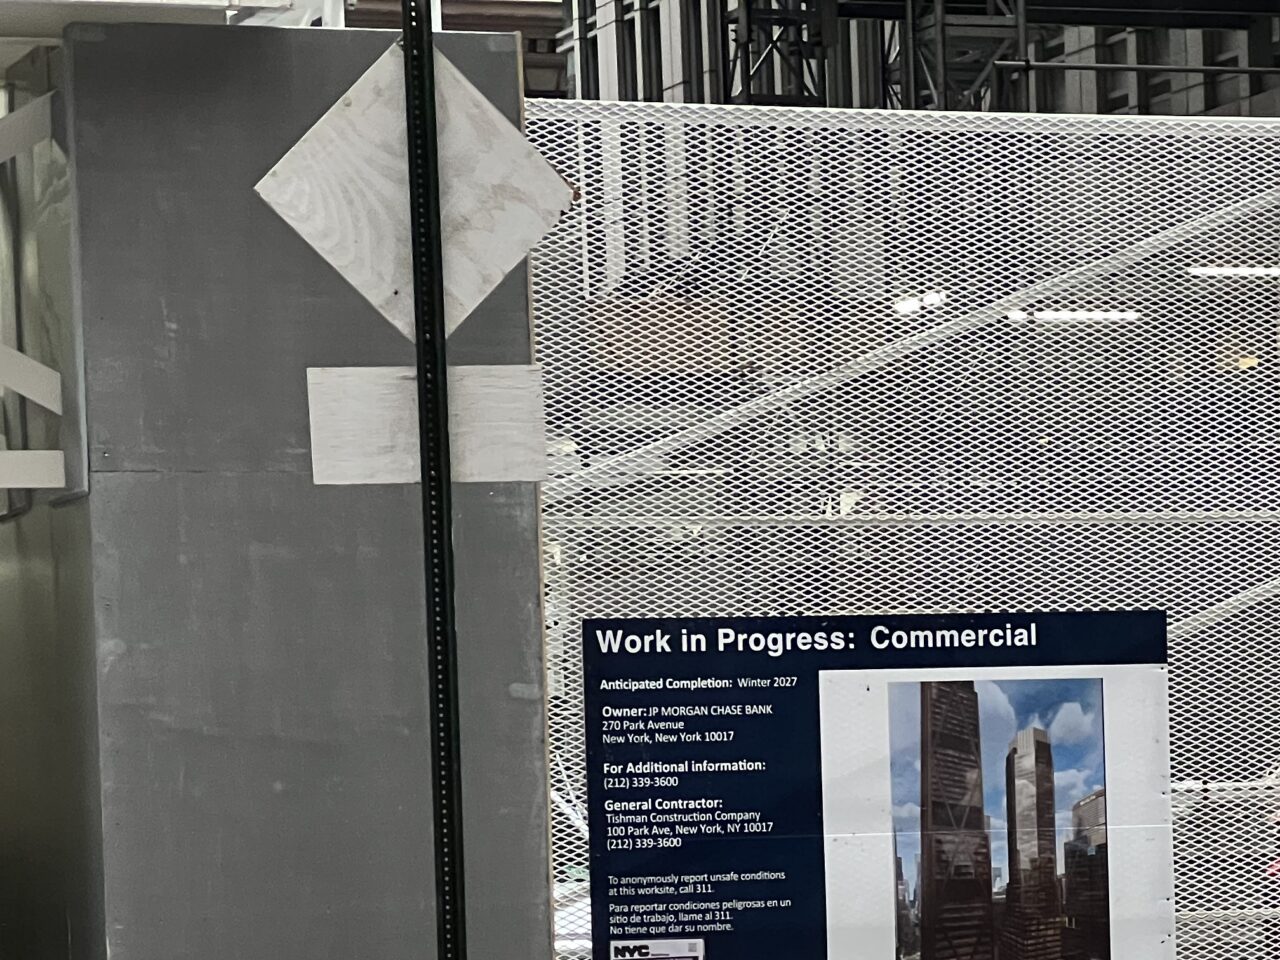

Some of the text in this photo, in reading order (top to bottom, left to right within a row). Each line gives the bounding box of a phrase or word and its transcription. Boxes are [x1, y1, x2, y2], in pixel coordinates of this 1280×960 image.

[596, 622, 1037, 657] Work in Progress: Commercial
[600, 676, 798, 692] Anticipated Completion: Winter 2027
[602, 704, 772, 717] Owner: JP MORGAN CHASE BANK
[602, 720, 684, 730] 270 Park Avenue
[602, 731, 734, 744] New York, New York 10017
[604, 759, 766, 774] For Additional information:
[604, 776, 678, 790] (212) 339-3600
[604, 798, 722, 812] General Contractor:
[606, 811, 760, 824] Tishman Construction Company
[607, 822, 774, 836] 100 Park Ave, New York, NY 10017
[606, 838, 682, 850] (212) 339-3600
[608, 870, 786, 885] To anonymously report unsafe conditions
[620, 886, 636, 896] this
[637, 886, 678, 894] worksite,
[679, 884, 694, 894] call
[609, 904, 628, 912] Para
[630, 903, 667, 913] reportar
[668, 900, 720, 910] condiciones
[722, 900, 766, 910] peligrosas
[610, 915, 628, 924] sitio
[630, 914, 642, 923] de
[643, 913, 676, 924] trabajo,
[678, 912, 702, 922] llame
[704, 912, 712, 920] al
[610, 926, 622, 934] No
[624, 926, 648, 934] tiene
[649, 926, 666, 935] que
[668, 924, 682, 932] dar
[697, 922, 734, 932] nombre.
[613, 944, 650, 958] NYC
